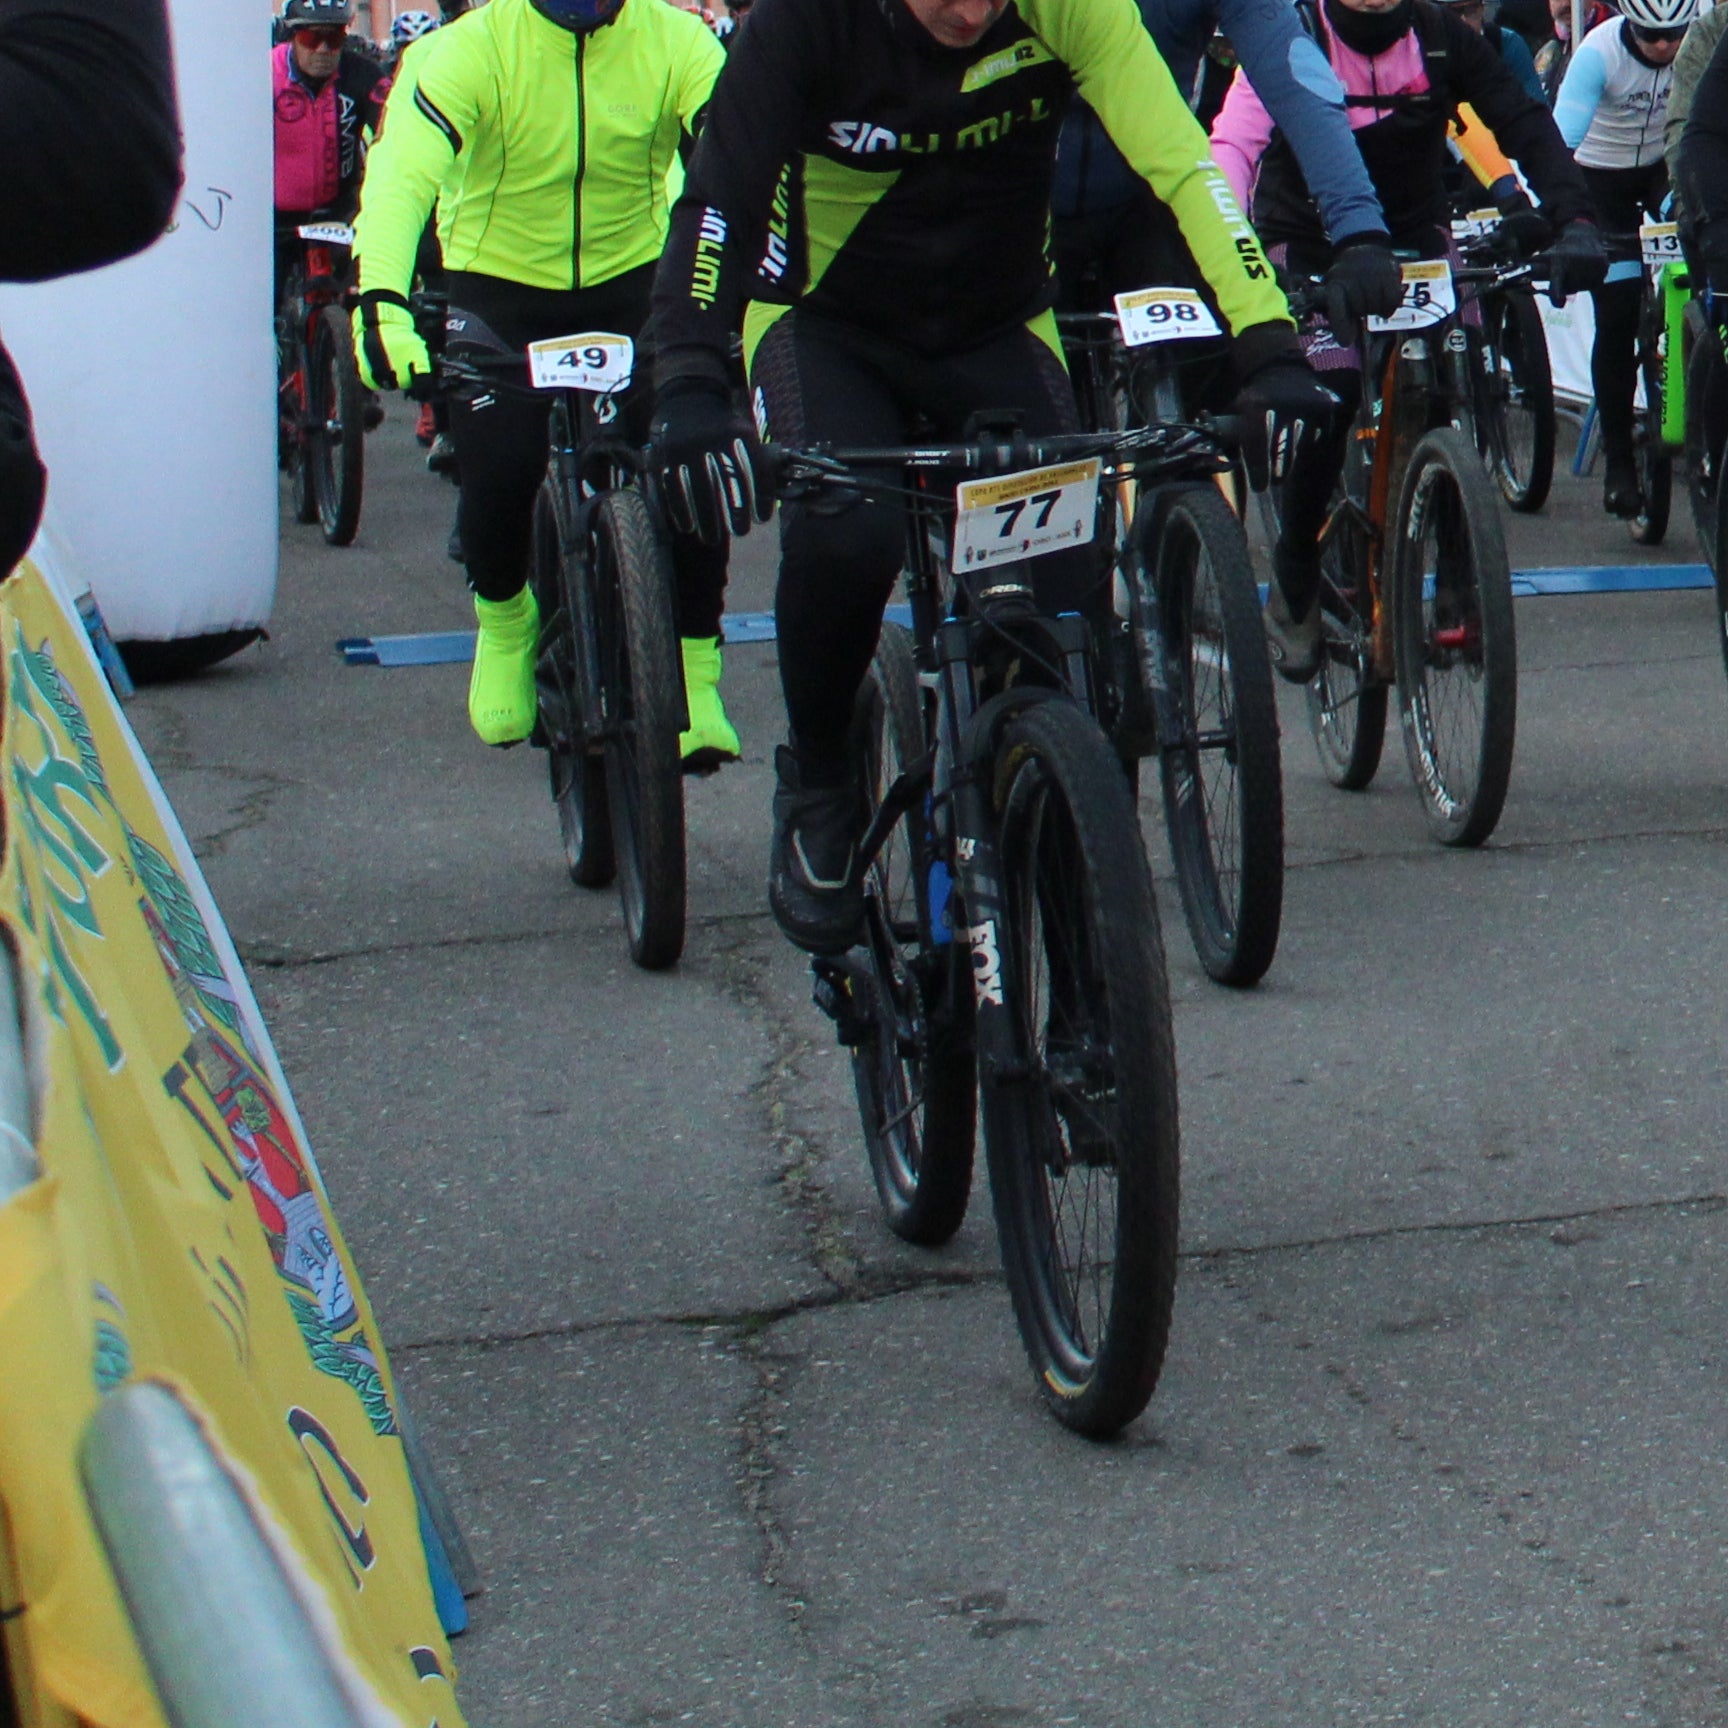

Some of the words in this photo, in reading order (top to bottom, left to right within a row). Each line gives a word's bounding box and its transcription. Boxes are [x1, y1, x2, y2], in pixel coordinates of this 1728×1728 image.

[1145, 302, 1200, 324] 98
[556, 347, 609, 370] 49
[994, 489, 1063, 539] 77
